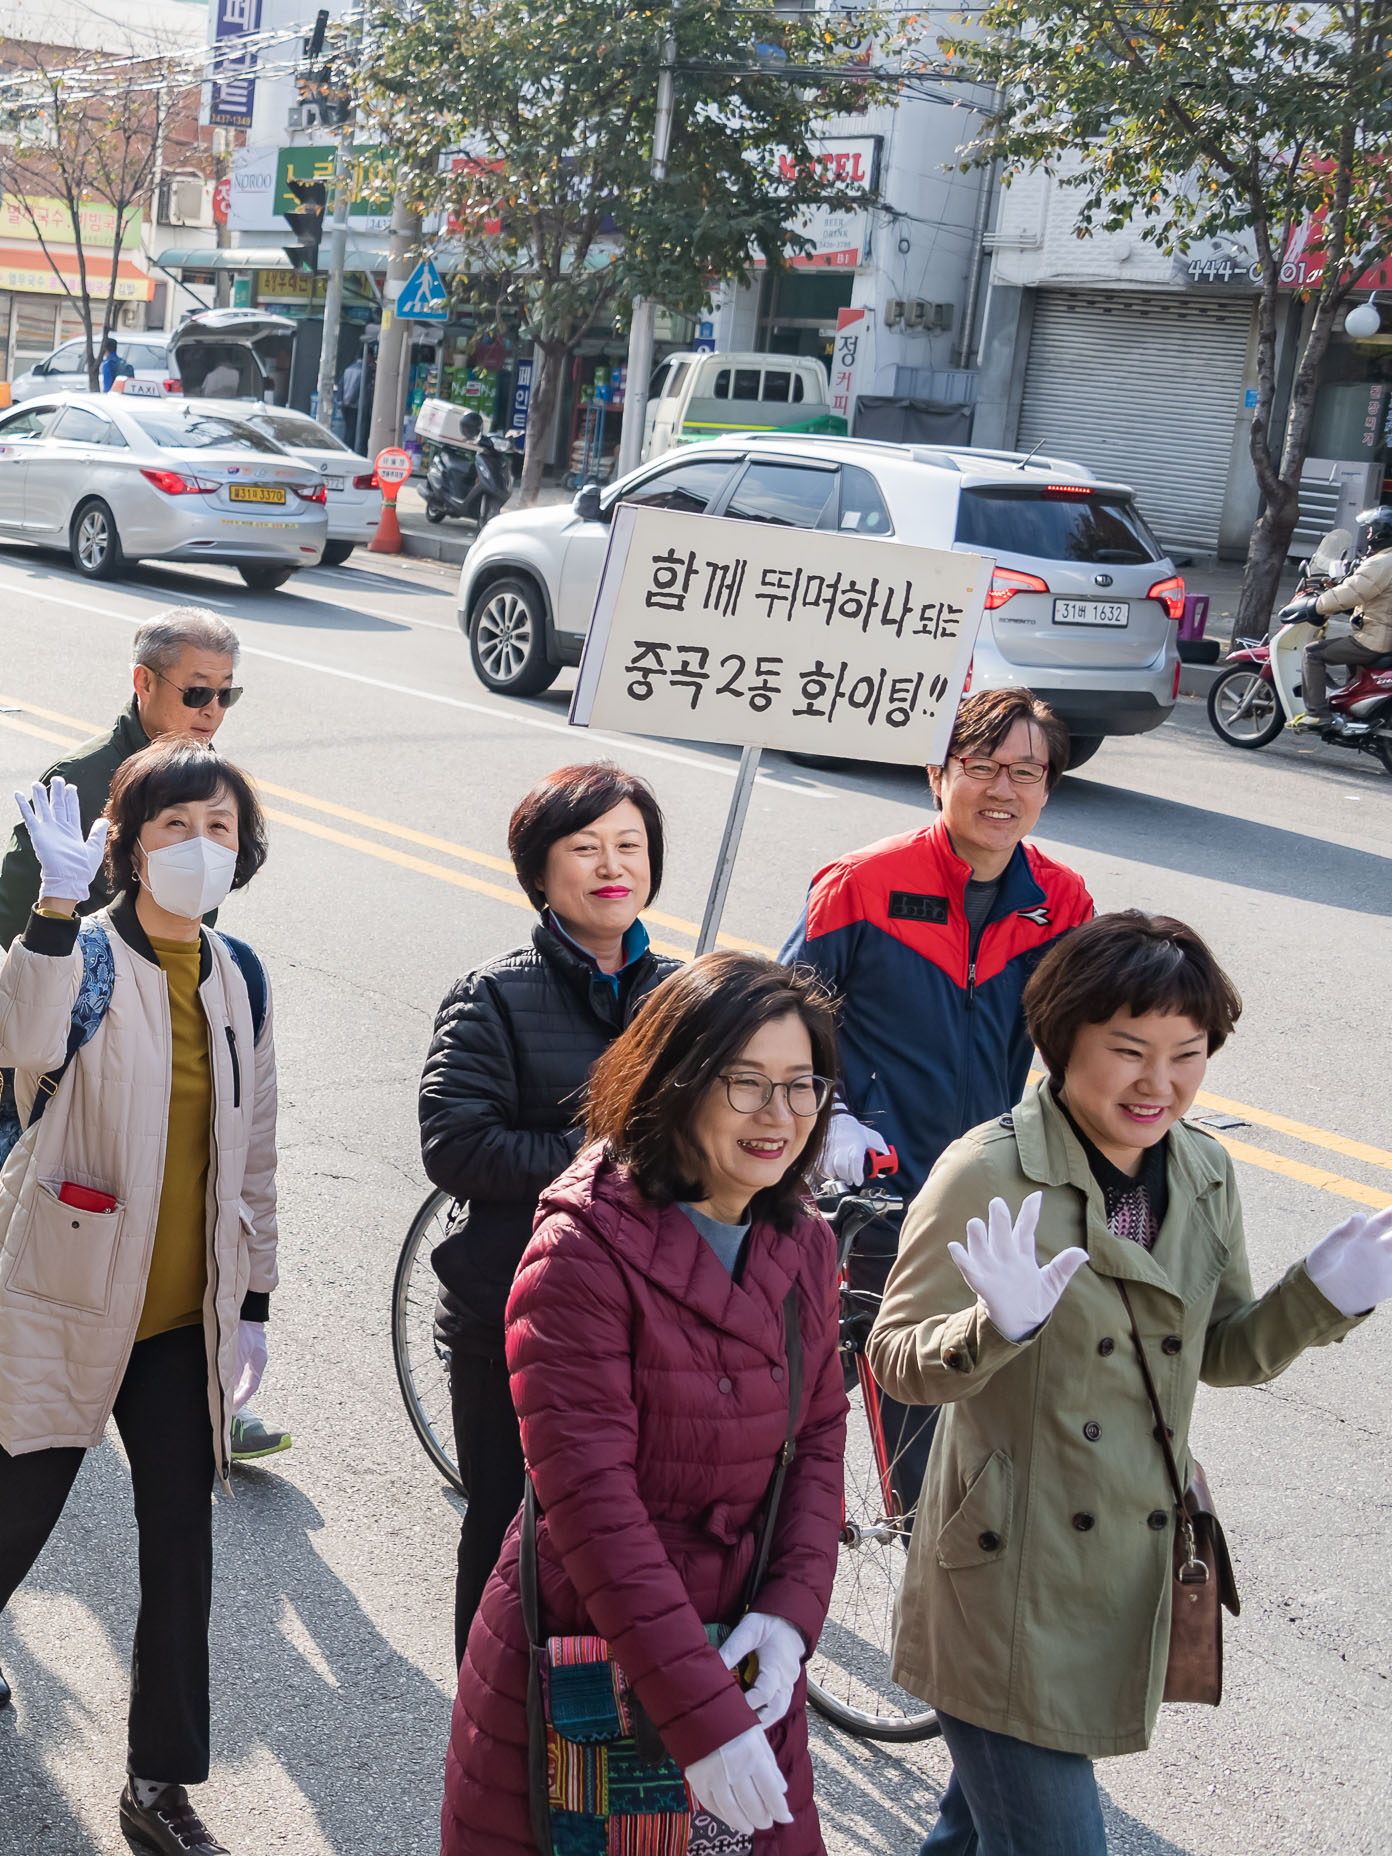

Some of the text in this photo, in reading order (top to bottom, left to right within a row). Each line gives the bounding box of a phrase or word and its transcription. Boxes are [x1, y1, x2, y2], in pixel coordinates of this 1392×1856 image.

[234, 173, 272, 189] NOROO
[779, 153, 865, 183] MTEL
[1188, 259, 1306, 284] 444-001
[838, 335, 859, 367] 정
[131, 384, 155, 395] TAXI
[513, 365, 532, 427] 페인트
[645, 547, 748, 617] 함께
[1092, 605, 1123, 622] 1632
[625, 639, 784, 712] 중곡2동
